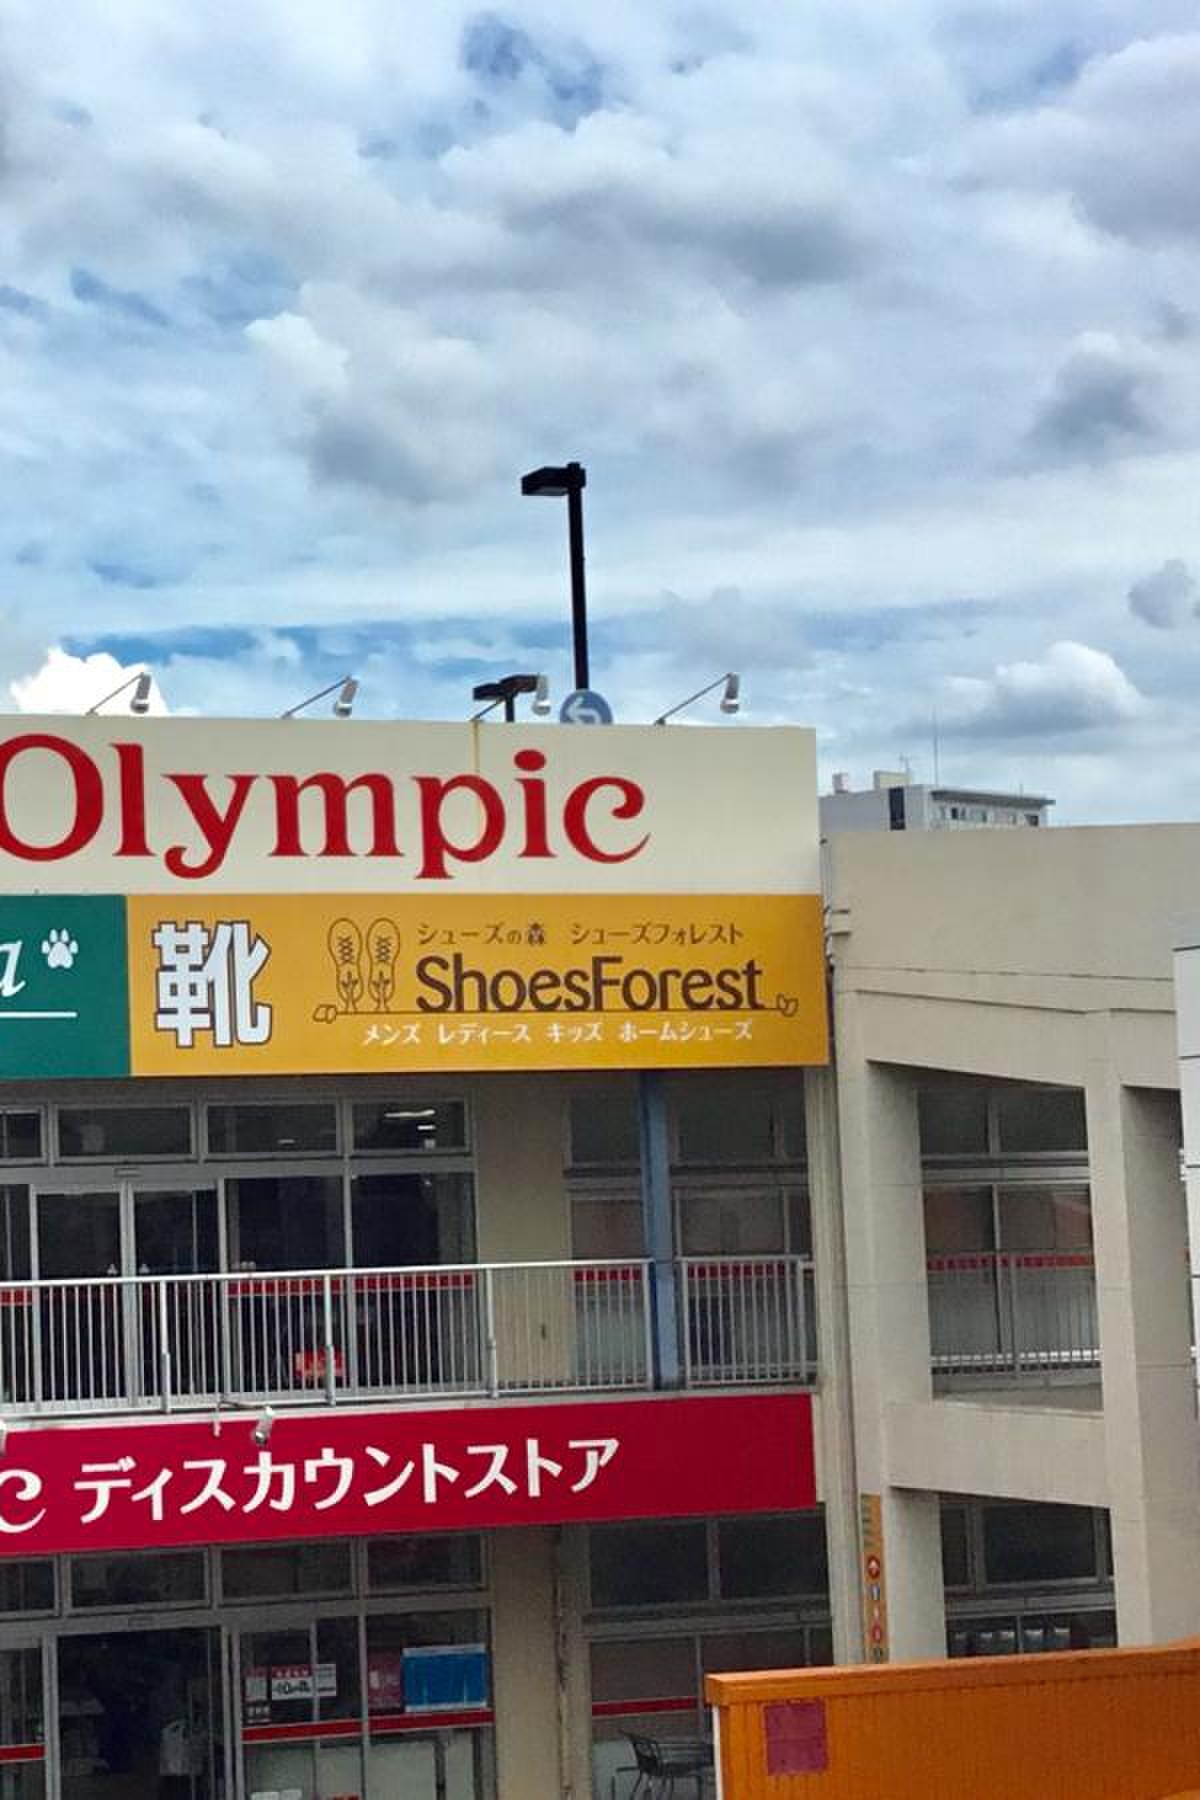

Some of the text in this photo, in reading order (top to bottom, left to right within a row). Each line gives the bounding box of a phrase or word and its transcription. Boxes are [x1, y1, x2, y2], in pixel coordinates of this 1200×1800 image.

[417, 922, 745, 946] シューズの森 シューズフォレスト
[151, 920, 272, 1048] 靴
[415, 952, 766, 1013] ShoesForest
[362, 1022, 421, 1045] メンズ
[546, 1021, 604, 1044] キッズ
[72, 1435, 621, 1523] ディスカウントストア
